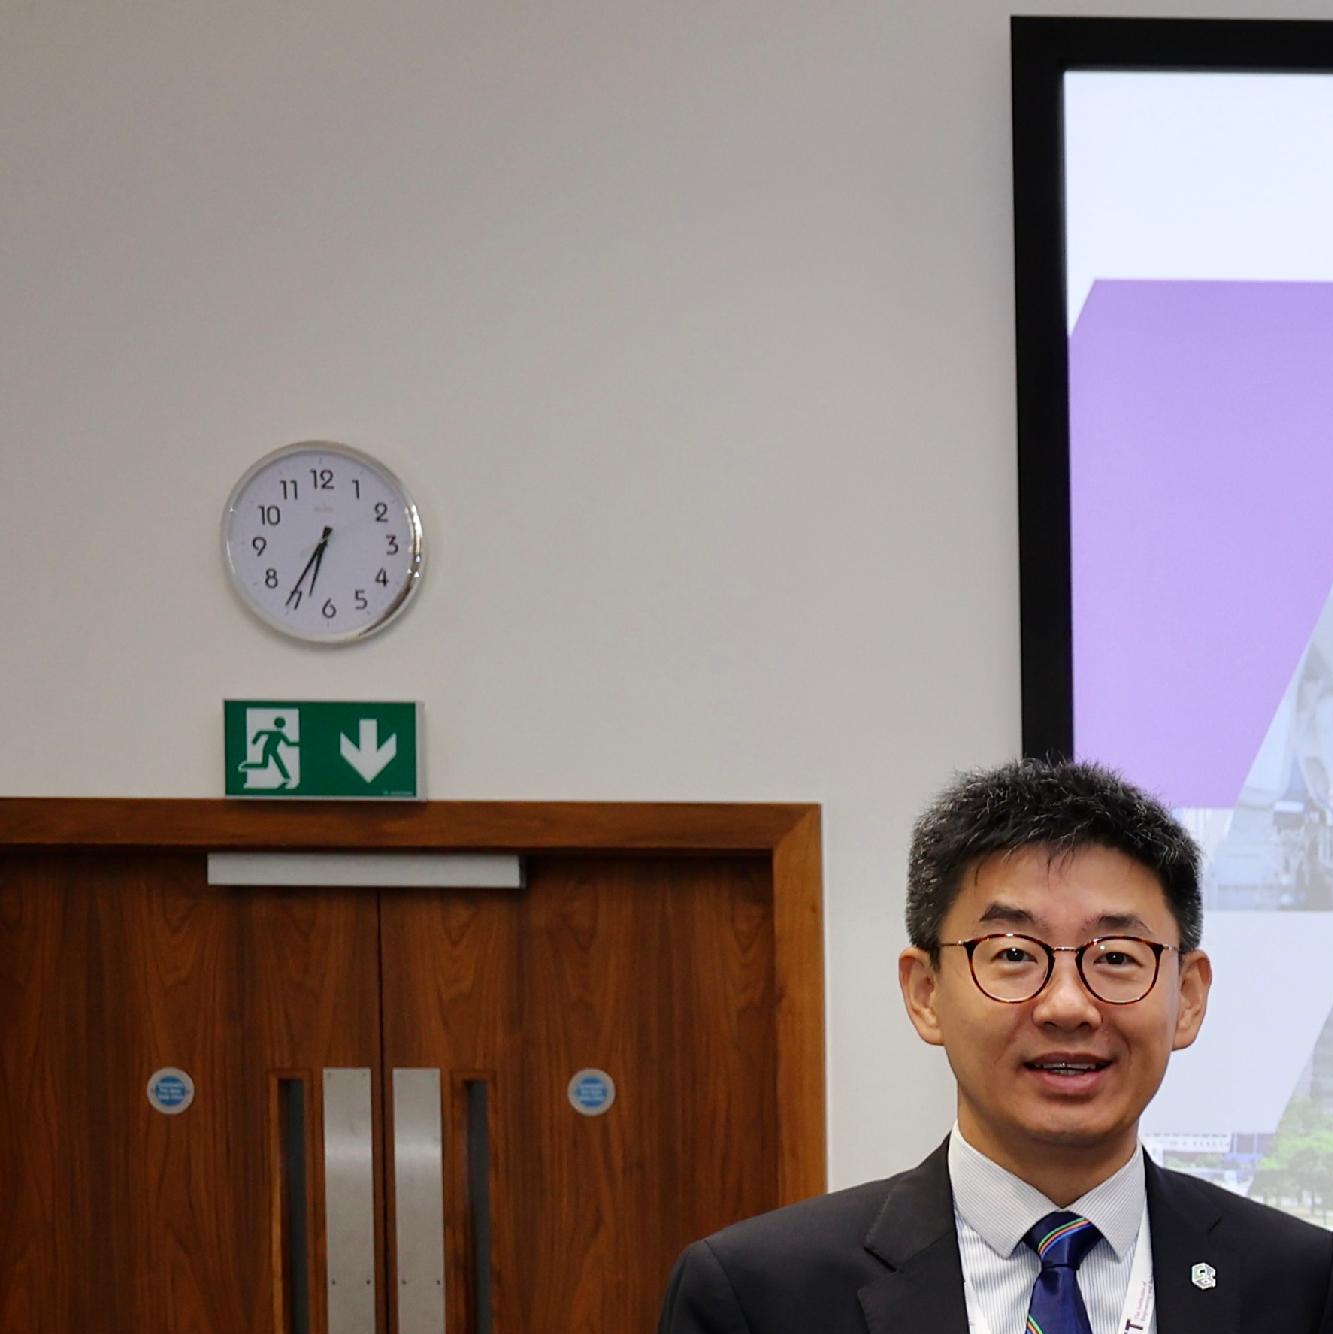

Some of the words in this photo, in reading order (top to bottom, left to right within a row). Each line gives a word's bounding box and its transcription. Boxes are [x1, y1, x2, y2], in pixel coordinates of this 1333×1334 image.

[310, 469, 335, 489] 12
[280, 480, 299, 500] 11
[352, 480, 360, 499] 1
[258, 505, 281, 525] 10
[374, 502, 389, 522] 2
[252, 537, 267, 556] 9
[386, 535, 399, 555] 3
[265, 568, 279, 589] 8
[375, 568, 389, 587] 4
[322, 598, 337, 618] 6
[355, 589, 368, 610] 5
